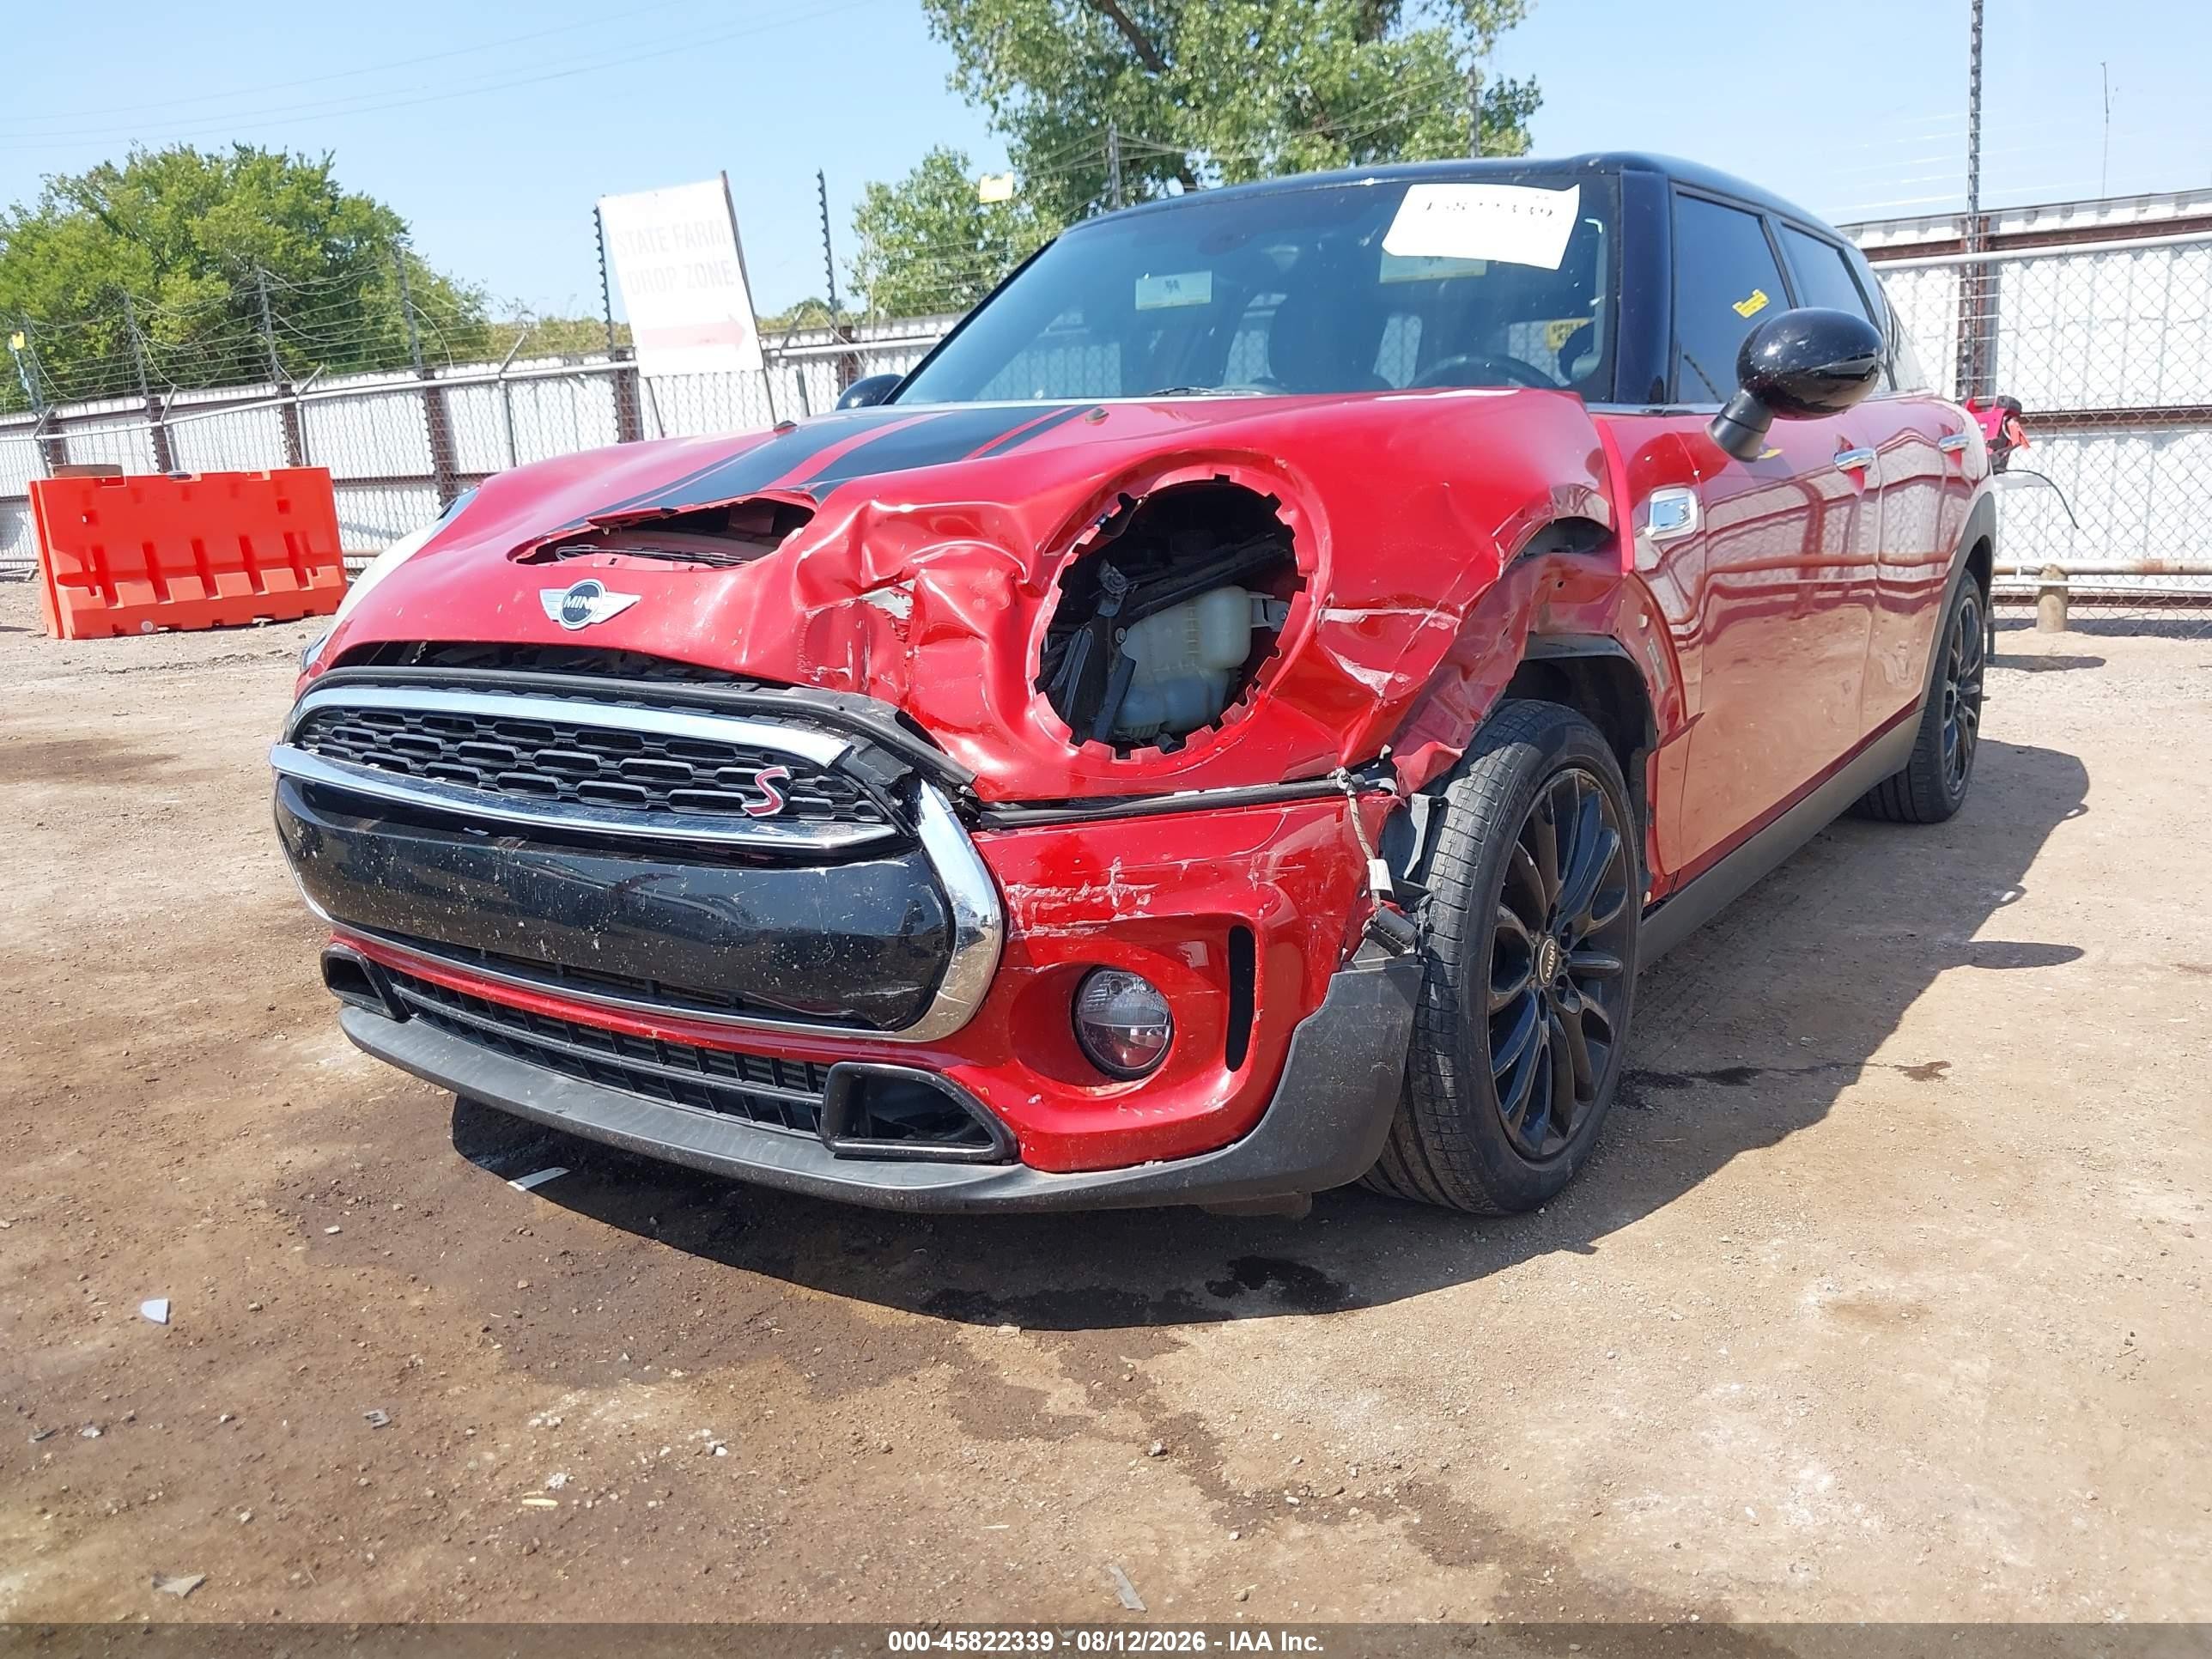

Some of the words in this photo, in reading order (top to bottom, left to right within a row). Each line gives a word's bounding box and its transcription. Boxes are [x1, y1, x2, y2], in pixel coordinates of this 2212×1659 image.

[616, 227, 670, 257] STATE
[673, 221, 727, 250] FARM
[627, 266, 678, 295] DROP
[684, 260, 735, 289] ZONE
[741, 766, 790, 817] S
[1545, 945, 1557, 981] MINI
